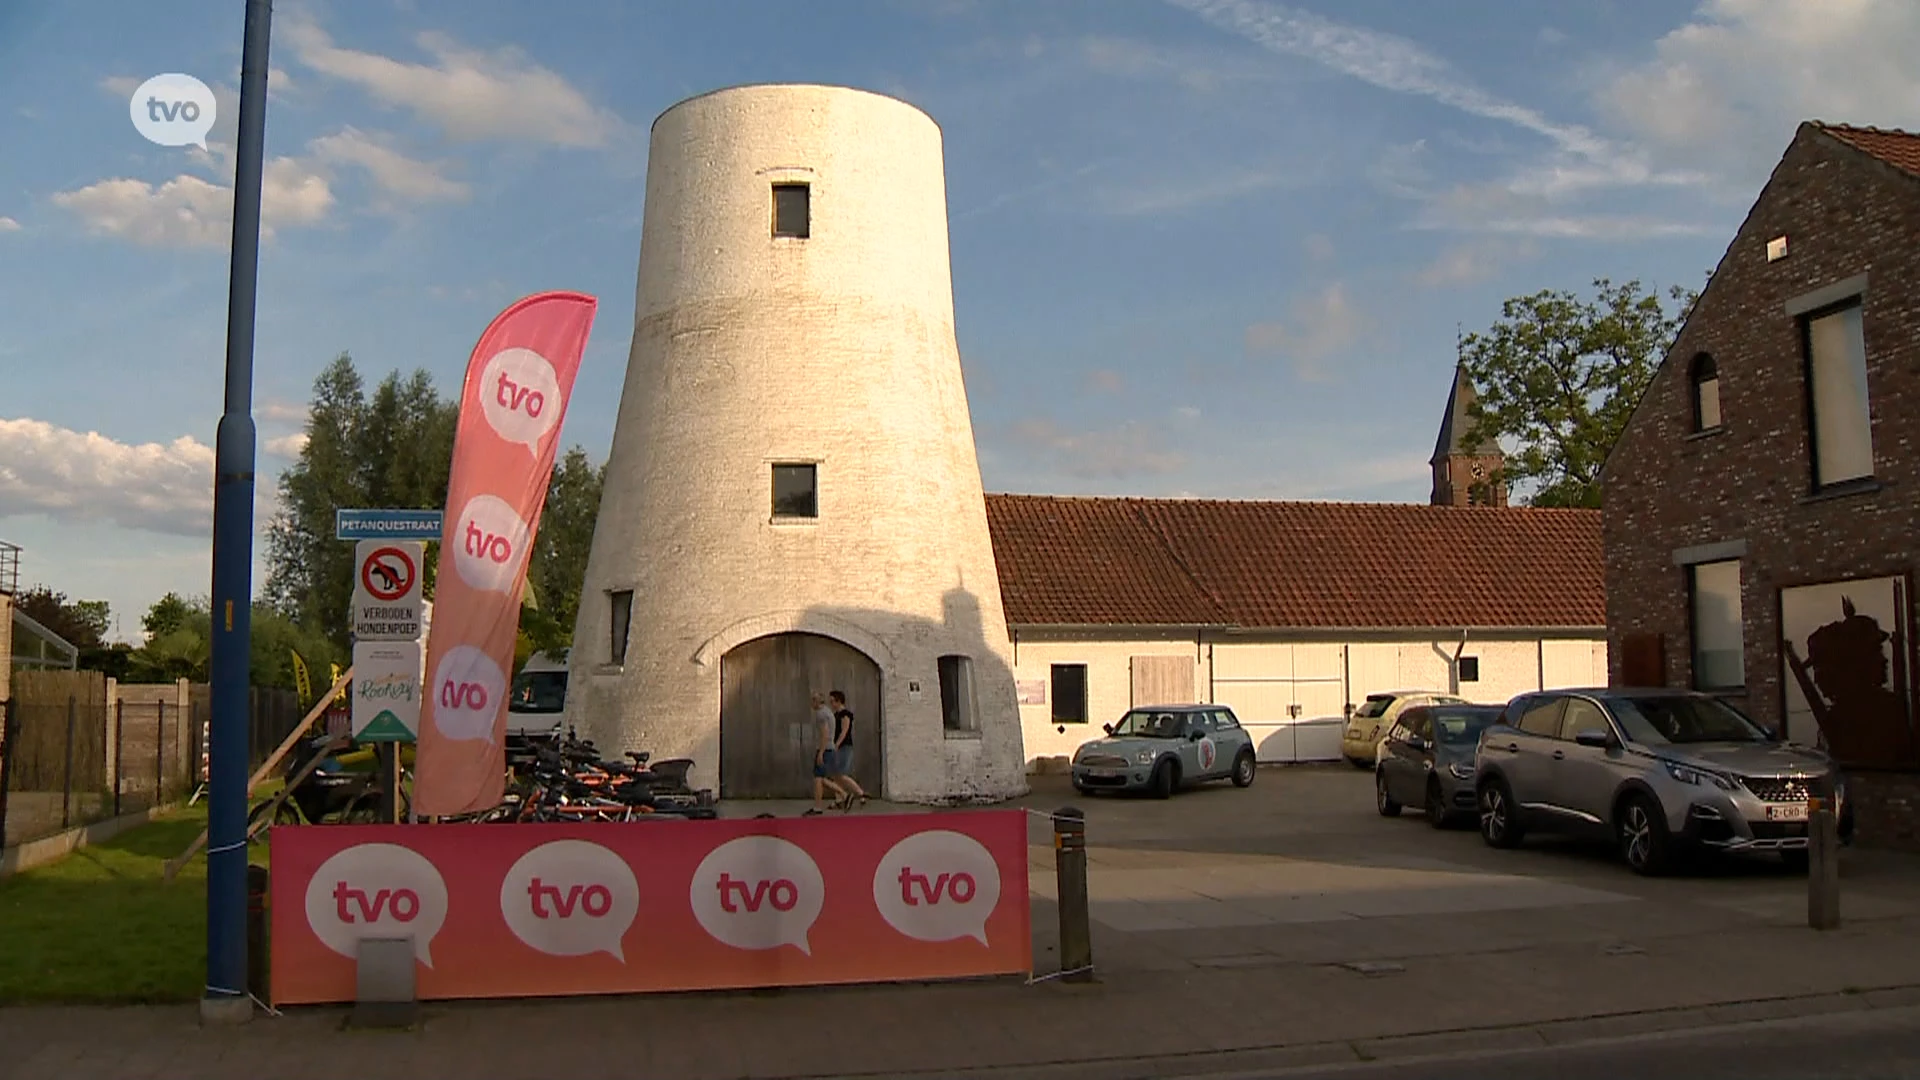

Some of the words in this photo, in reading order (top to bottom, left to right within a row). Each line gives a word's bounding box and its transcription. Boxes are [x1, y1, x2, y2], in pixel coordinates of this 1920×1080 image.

[497, 371, 545, 418] tvo
[341, 520, 440, 532] PETANQUESTRAAT
[465, 519, 513, 562] tvo
[357, 623, 418, 635] HONDENPOEP
[363, 607, 412, 620] VERBODEN
[333, 881, 420, 922] tvo
[528, 877, 612, 919] tvo
[717, 872, 799, 912] tvo
[898, 866, 976, 905] tvo
